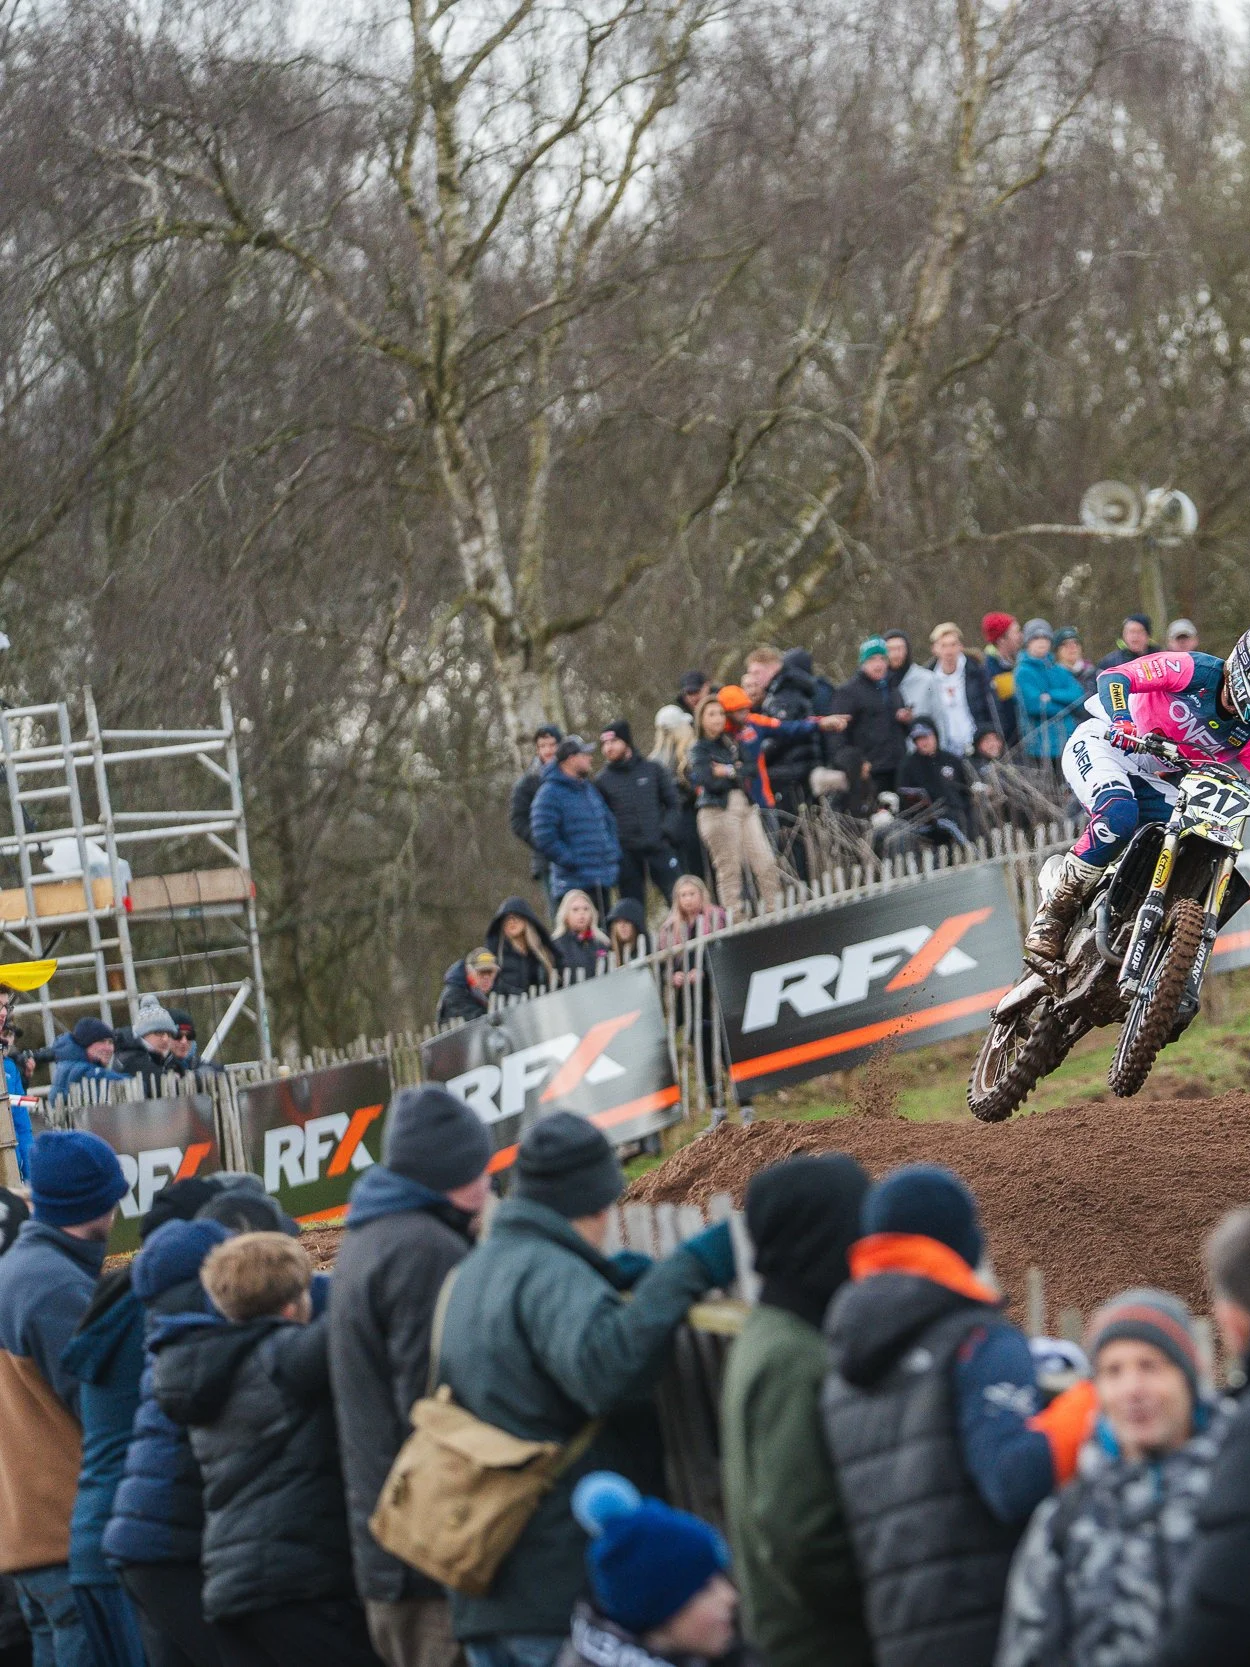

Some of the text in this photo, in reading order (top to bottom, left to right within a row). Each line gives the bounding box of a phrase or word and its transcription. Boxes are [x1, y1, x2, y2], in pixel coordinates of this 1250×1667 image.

[1165, 659, 1181, 674] 7
[1187, 780, 1250, 819] 217
[742, 906, 993, 1034] RFX
[1131, 917, 1153, 971] DLOP
[446, 1008, 641, 1125] RFX
[263, 1103, 384, 1194] RFX
